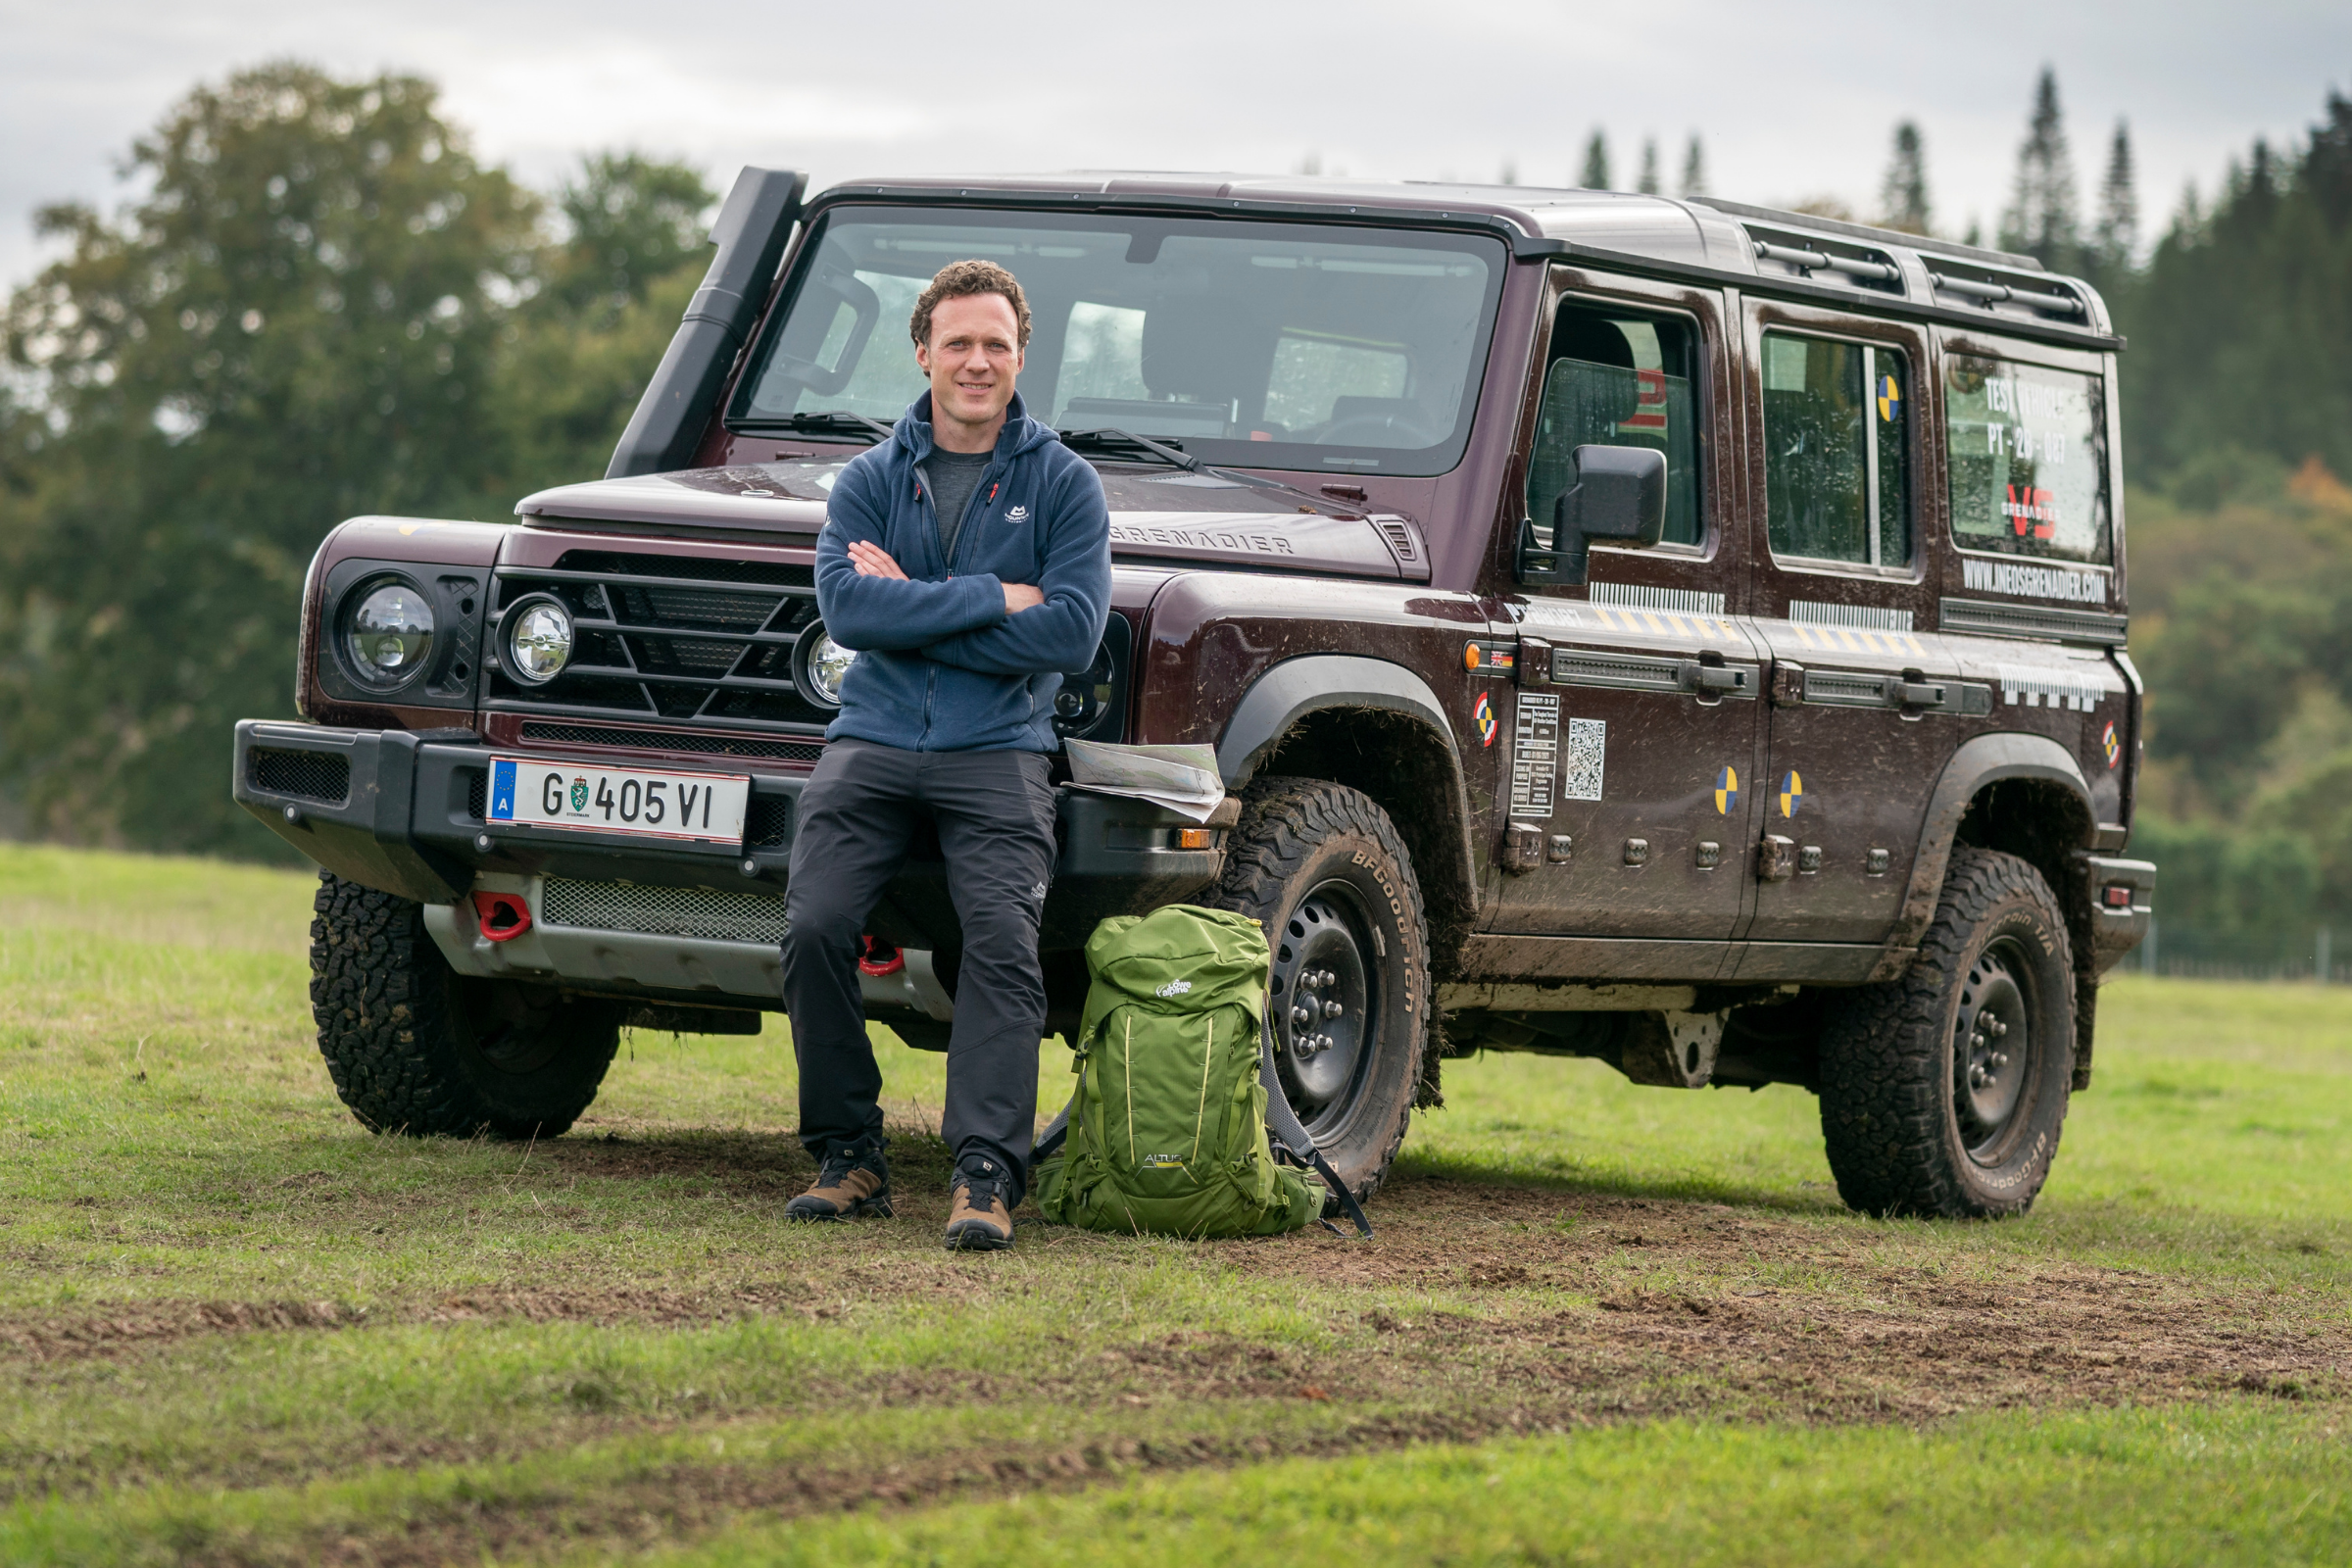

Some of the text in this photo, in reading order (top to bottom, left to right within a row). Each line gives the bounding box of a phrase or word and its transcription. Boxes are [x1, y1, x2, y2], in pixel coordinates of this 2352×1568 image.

[1984, 377, 2065, 420] TEST VEHICLE
[1987, 422, 2004, 456] PT
[2016, 426, 2034, 460] 2B
[2044, 430, 2066, 465] 087
[2000, 501, 2062, 521] GRENADIER
[1109, 525, 1295, 555] GRENADIER
[1962, 558, 2106, 605] WWW.INEOSGRENADIER.COM
[498, 798, 509, 811] A
[543, 772, 712, 829] G 405 VI
[1351, 849, 1415, 1013] BFGoodrich
[1162, 987, 1189, 998] alpine
[1145, 1153, 1182, 1164] ALTUS
